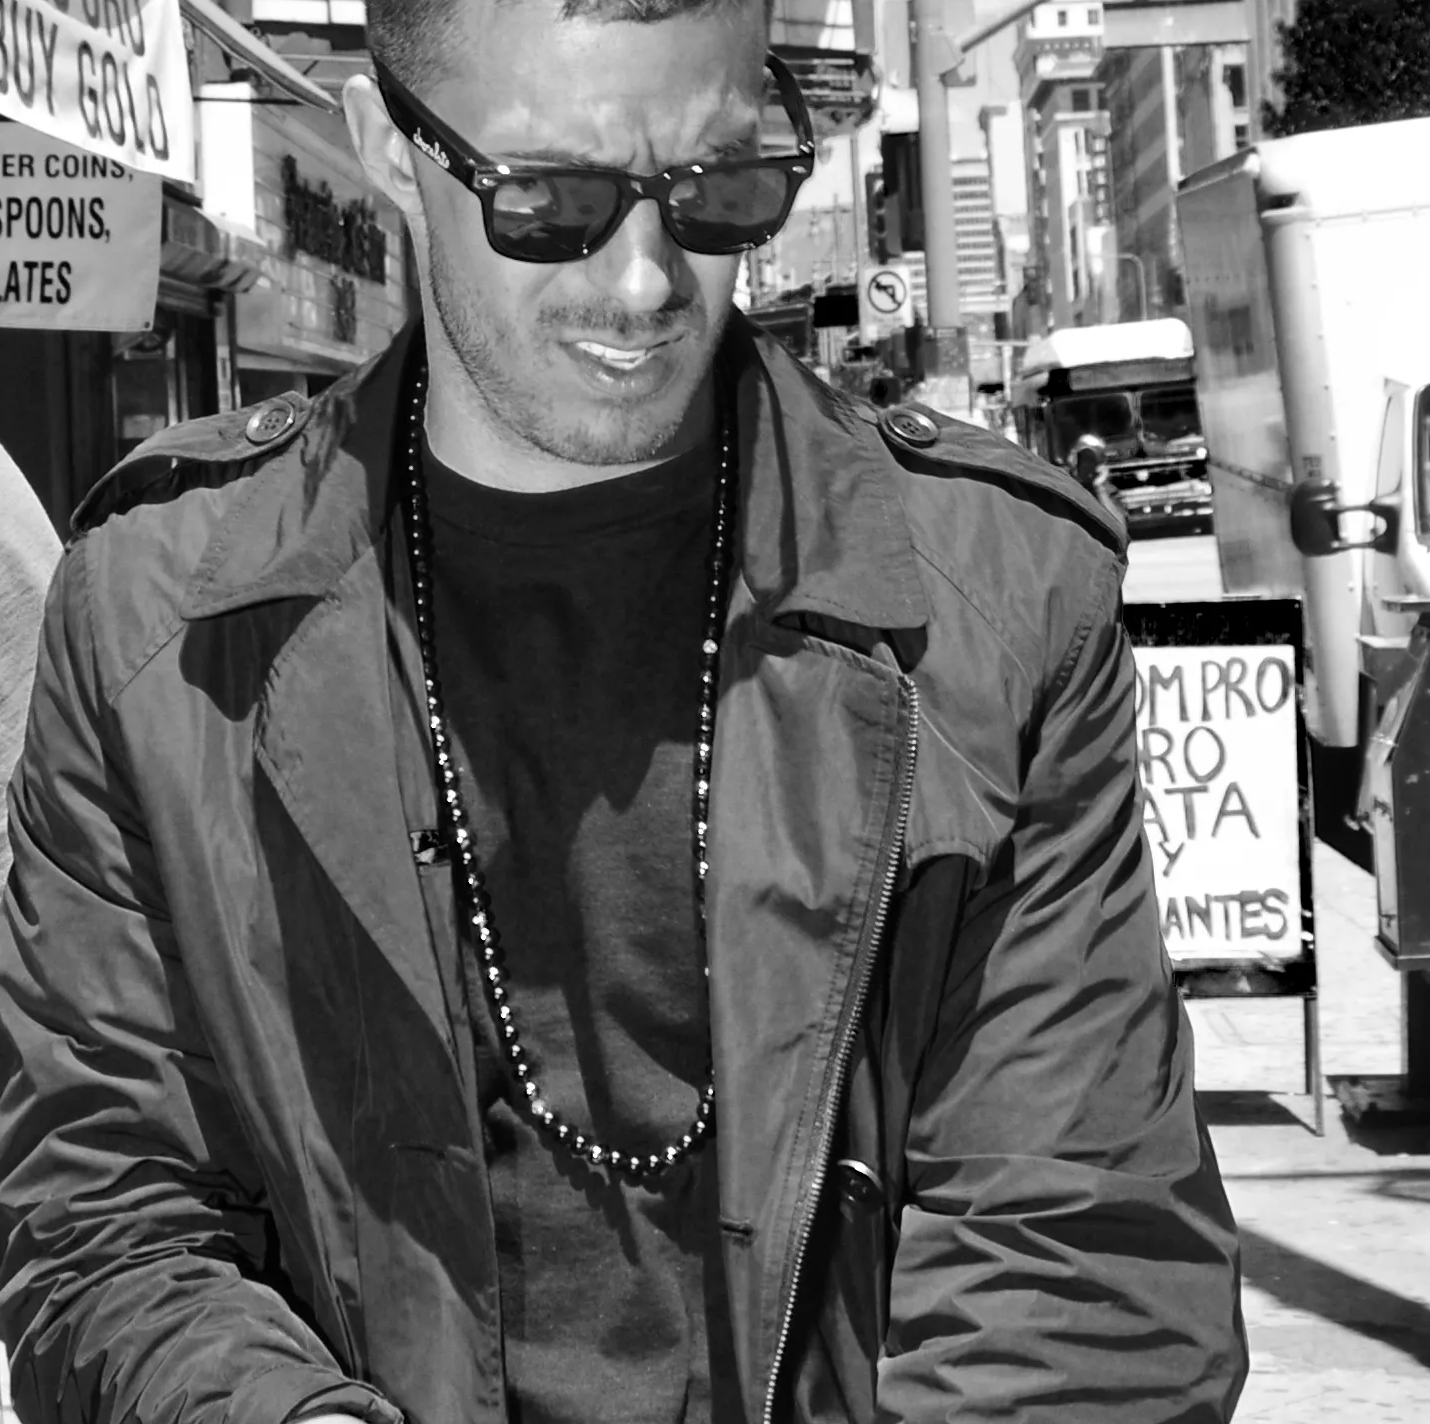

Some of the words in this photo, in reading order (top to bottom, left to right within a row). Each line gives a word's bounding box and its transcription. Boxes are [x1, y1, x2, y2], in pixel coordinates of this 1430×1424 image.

[78, 39, 169, 161] GOLD
[45, 155, 134, 182] COINS,
[1157, 841, 1185, 877] Y
